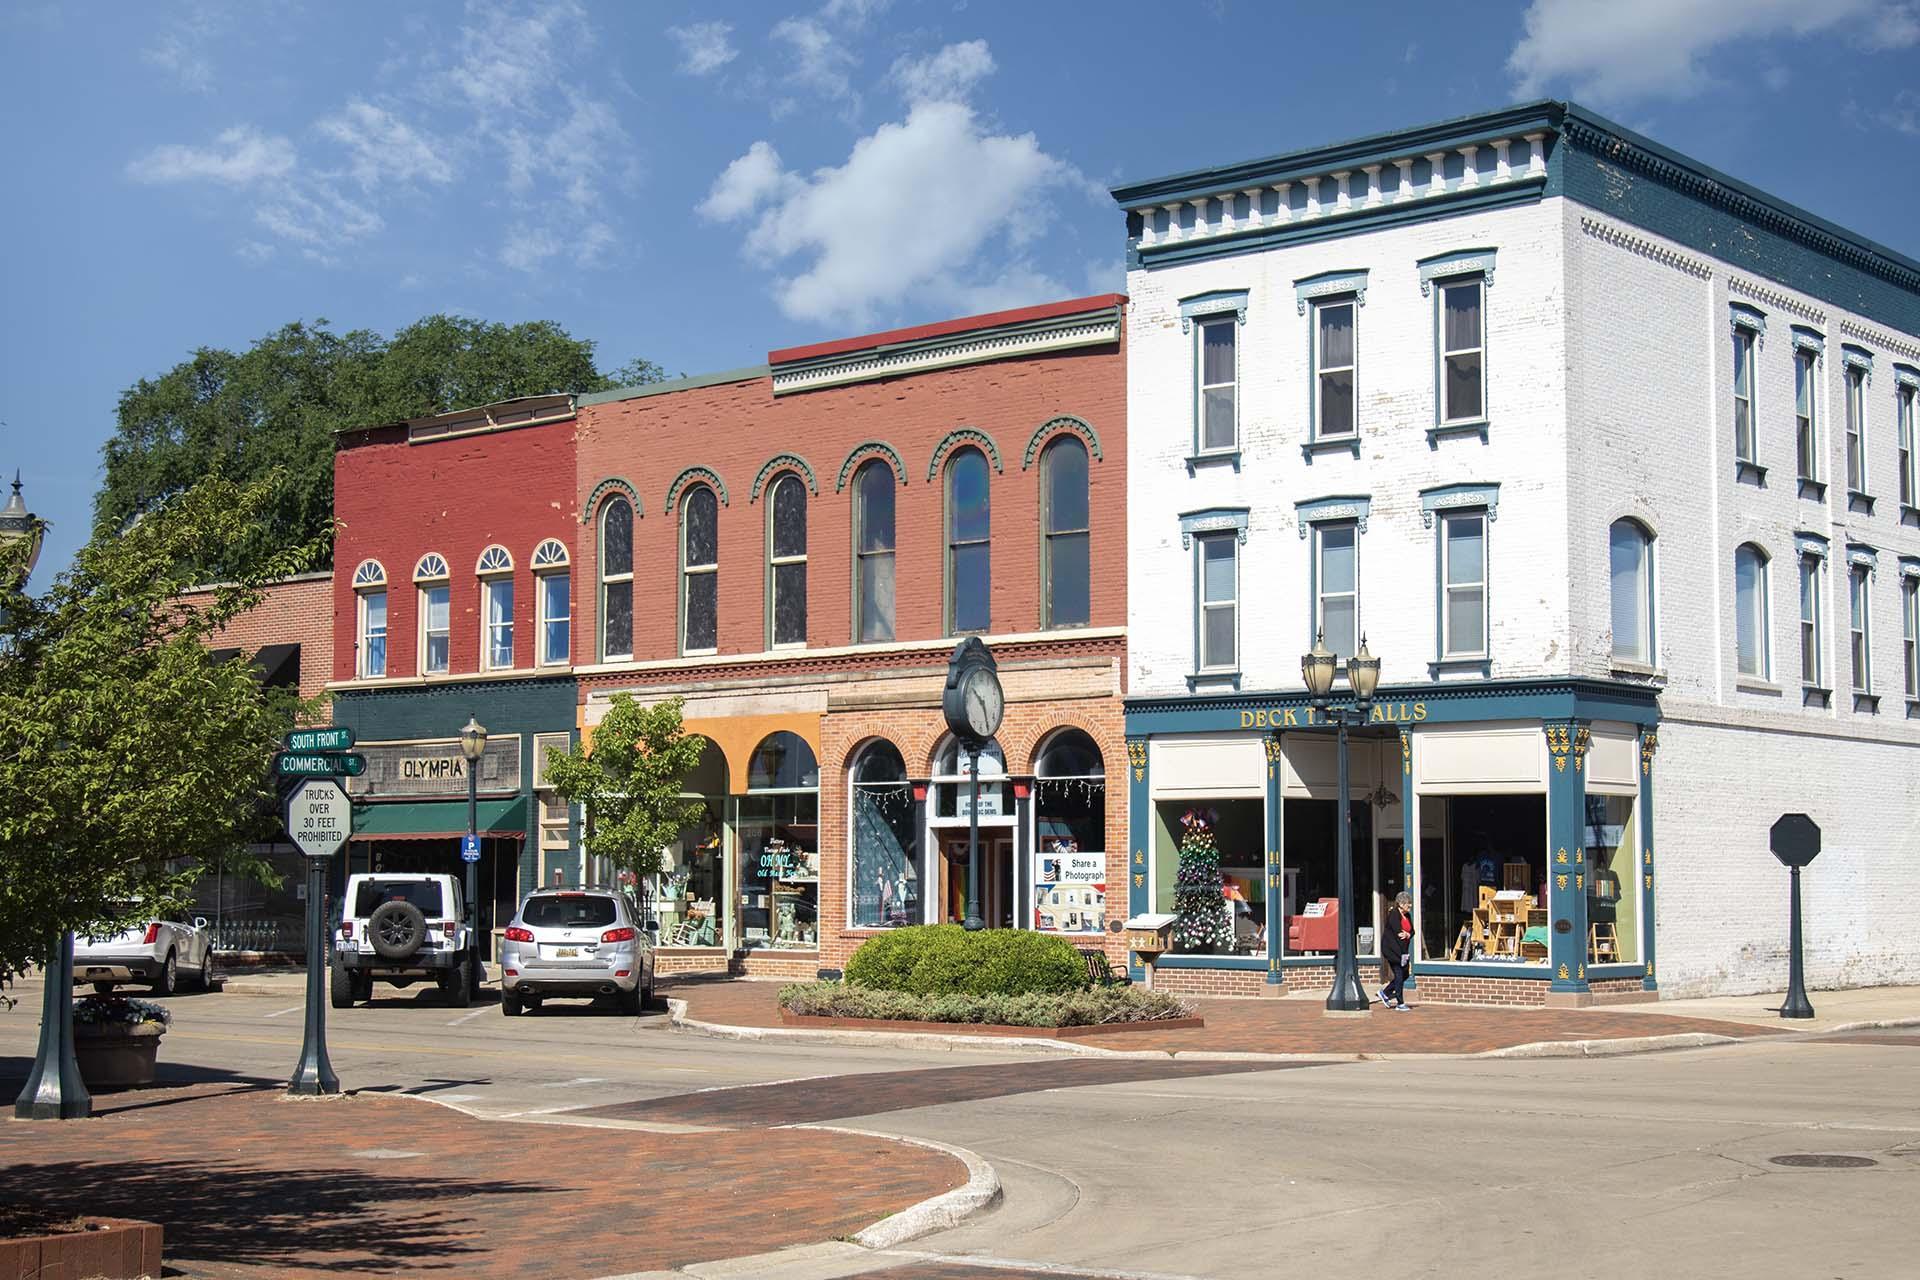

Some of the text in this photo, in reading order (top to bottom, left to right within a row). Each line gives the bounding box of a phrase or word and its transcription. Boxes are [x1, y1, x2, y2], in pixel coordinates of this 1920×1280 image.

[1240, 707, 1298, 728] DECK
[1370, 702, 1428, 722] ALLS
[292, 734, 315, 749] SOUTH
[317, 731, 339, 747] FRONT
[282, 757, 345, 771] COMMERCIAL
[404, 759, 462, 778] OLYMPIA
[305, 789, 335, 800] TRUCKS
[309, 803, 330, 814] OVER
[303, 817, 336, 828] 30 FEET
[297, 831, 342, 842] PROHIBITED
[468, 842, 475, 850] P
[1071, 859, 1097, 868] Share a
[1065, 871, 1104, 881] Photograph
